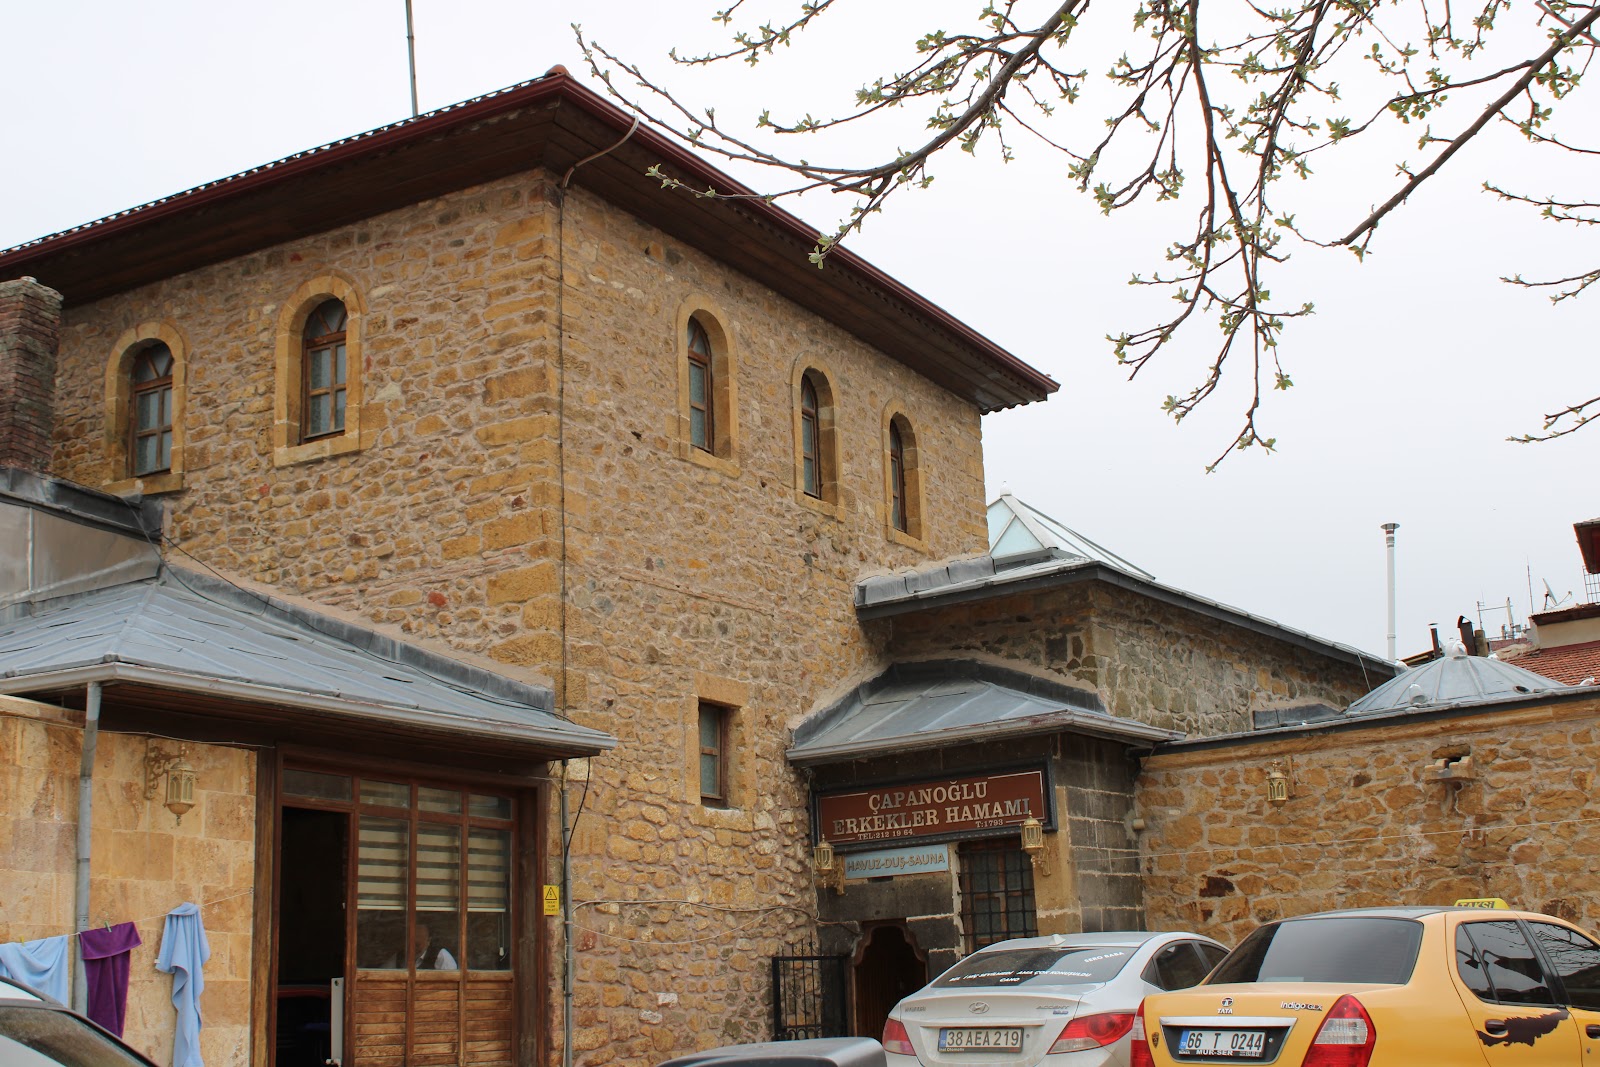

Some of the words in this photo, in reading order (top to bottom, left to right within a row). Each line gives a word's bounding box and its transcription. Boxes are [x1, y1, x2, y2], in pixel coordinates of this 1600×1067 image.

[868, 780, 988, 815] ÇAPANOĞLU
[832, 808, 940, 836] ERKEKLER
[945, 797, 1030, 824] HAMAMI
[975, 818, 1004, 828] T:1793
[857, 831, 890, 841] TEL:212
[847, 852, 945, 869] HAVUZ-DUŞ-SAUNA
[1280, 1001, 1306, 1011] Indigo
[947, 1031, 963, 1046] 38
[965, 1031, 990, 1046] AEA
[993, 1030, 1019, 1046] 219
[1187, 1032, 1203, 1049] 66
[1213, 1032, 1221, 1049] T
[1230, 1033, 1263, 1051] 0244
